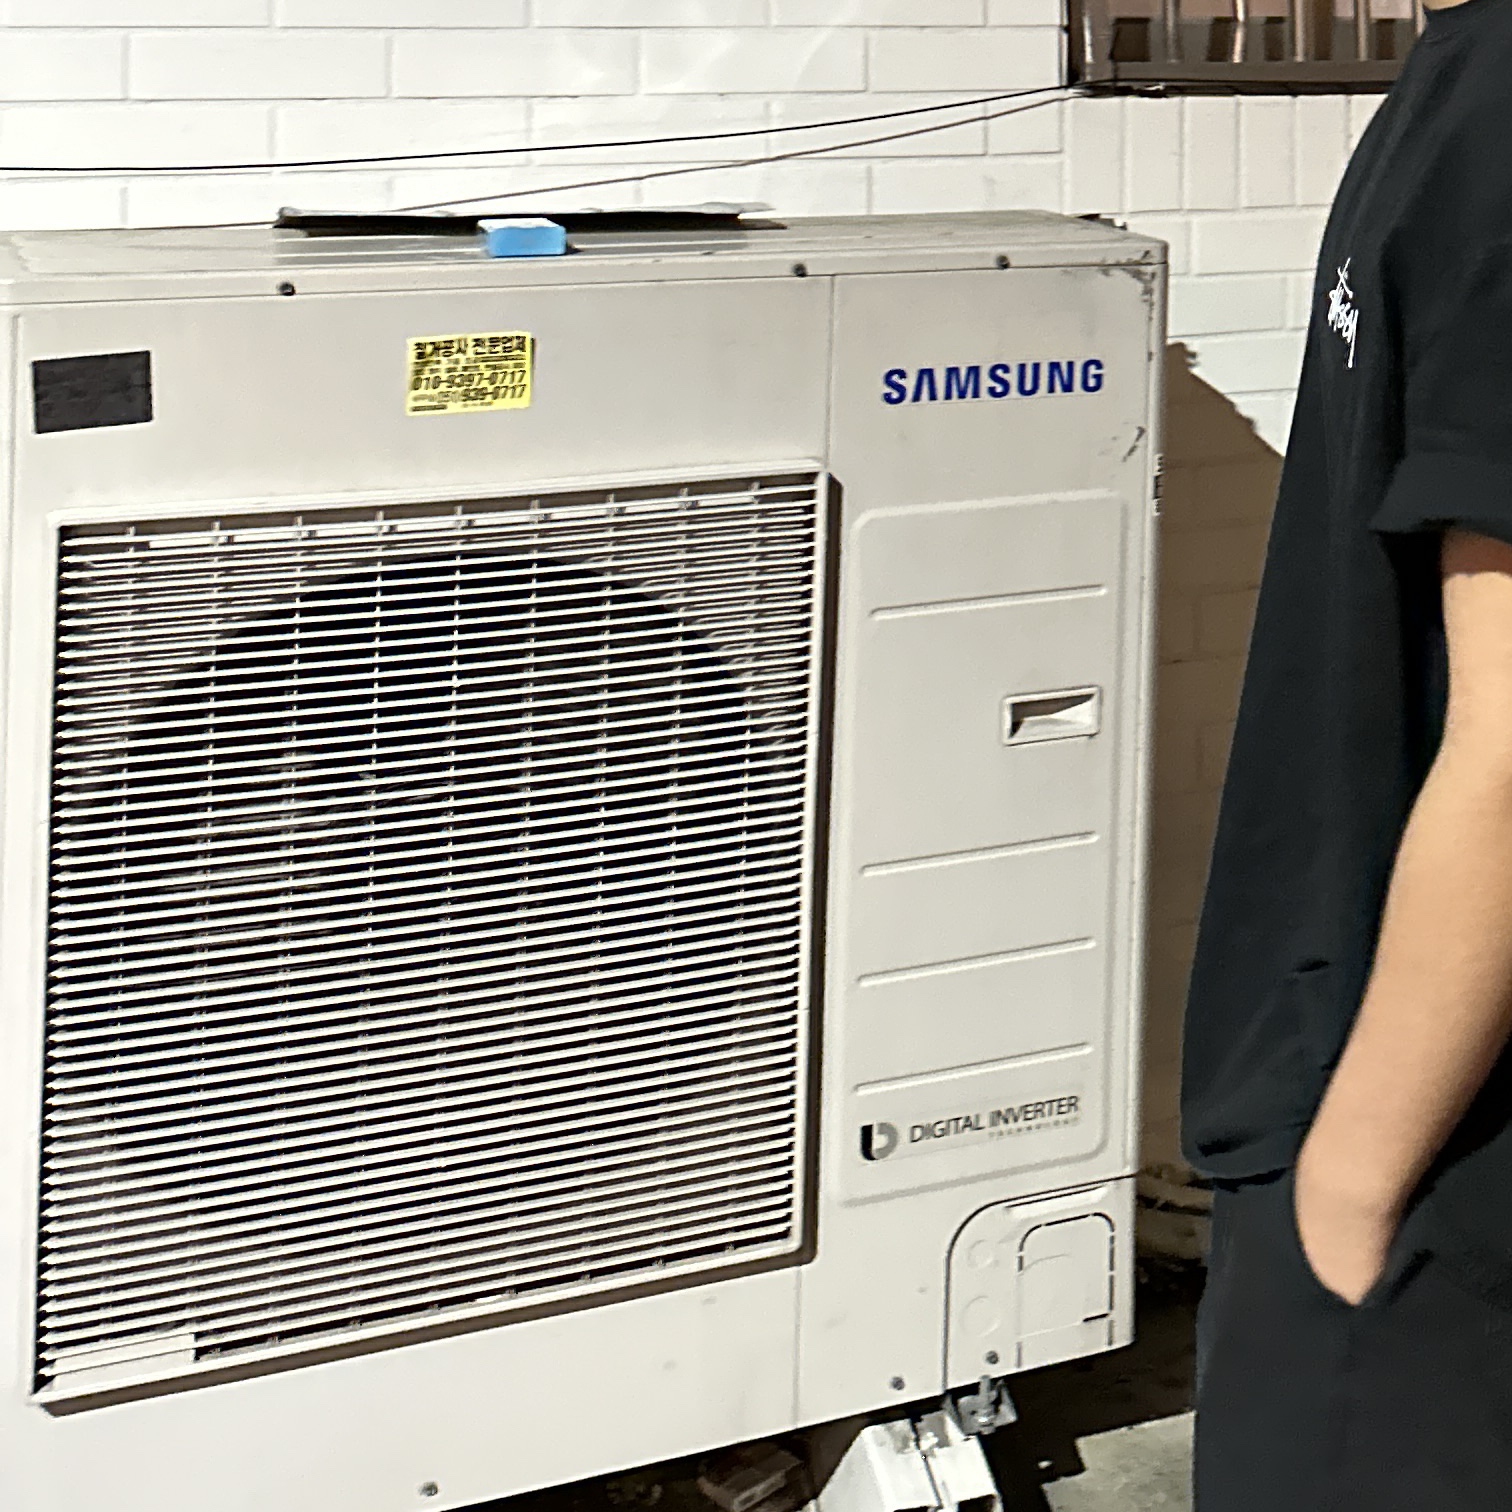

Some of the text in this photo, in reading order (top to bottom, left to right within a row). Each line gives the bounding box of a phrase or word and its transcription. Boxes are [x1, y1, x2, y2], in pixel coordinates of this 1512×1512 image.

[882, 359, 1106, 406] SAMSUNG
[909, 1113, 985, 1144] DIGITAL
[988, 1094, 1080, 1129] INVERTER
